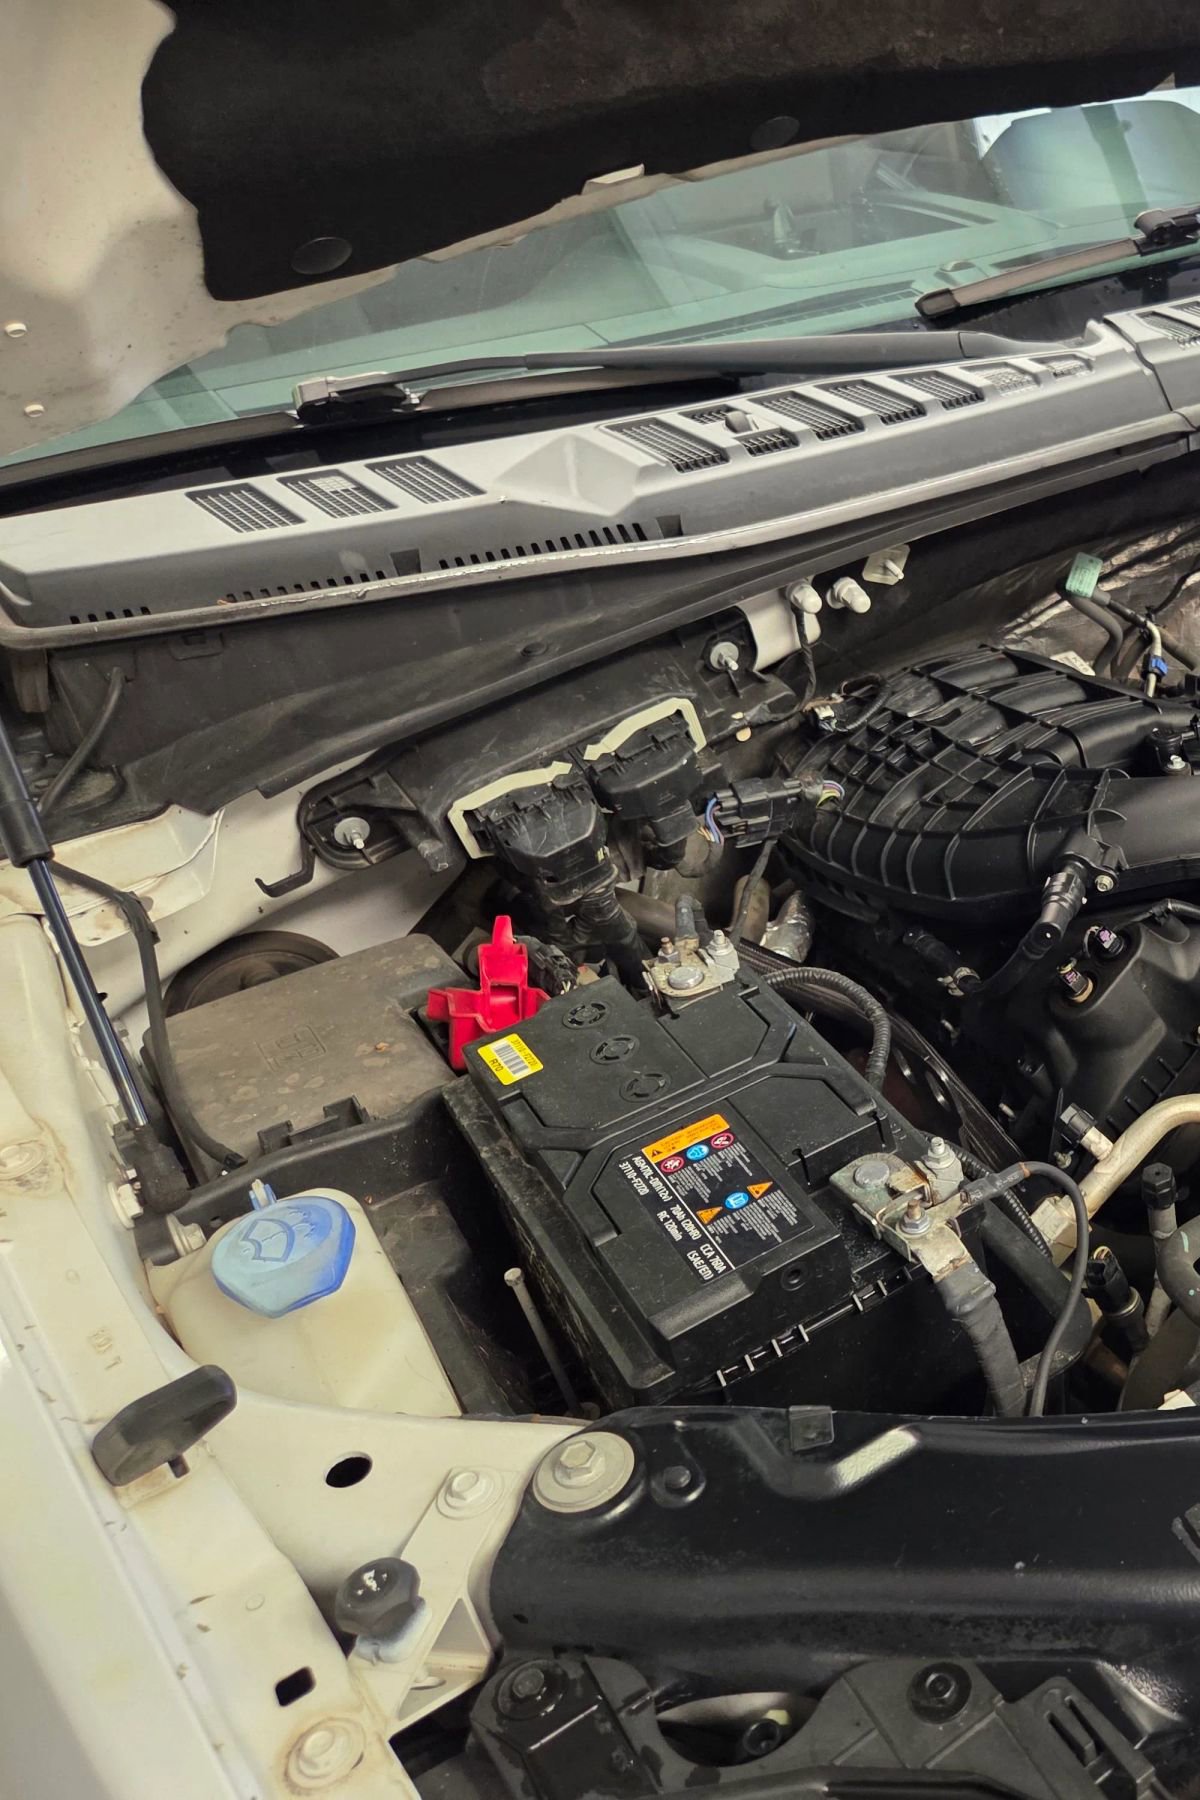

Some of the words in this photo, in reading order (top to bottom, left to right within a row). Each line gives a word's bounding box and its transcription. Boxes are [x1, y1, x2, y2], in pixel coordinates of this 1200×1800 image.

[489, 1058, 504, 1072] R70
[619, 1161, 650, 1196] 37110-F2720
[657, 1210, 670, 1222] RC
[664, 1219, 683, 1242] 120min
[670, 1204, 686, 1221] 70Ah
[681, 1219, 702, 1240] (20HR)
[700, 1244, 715, 1259] CCA
[709, 1255, 727, 1274] 760A
